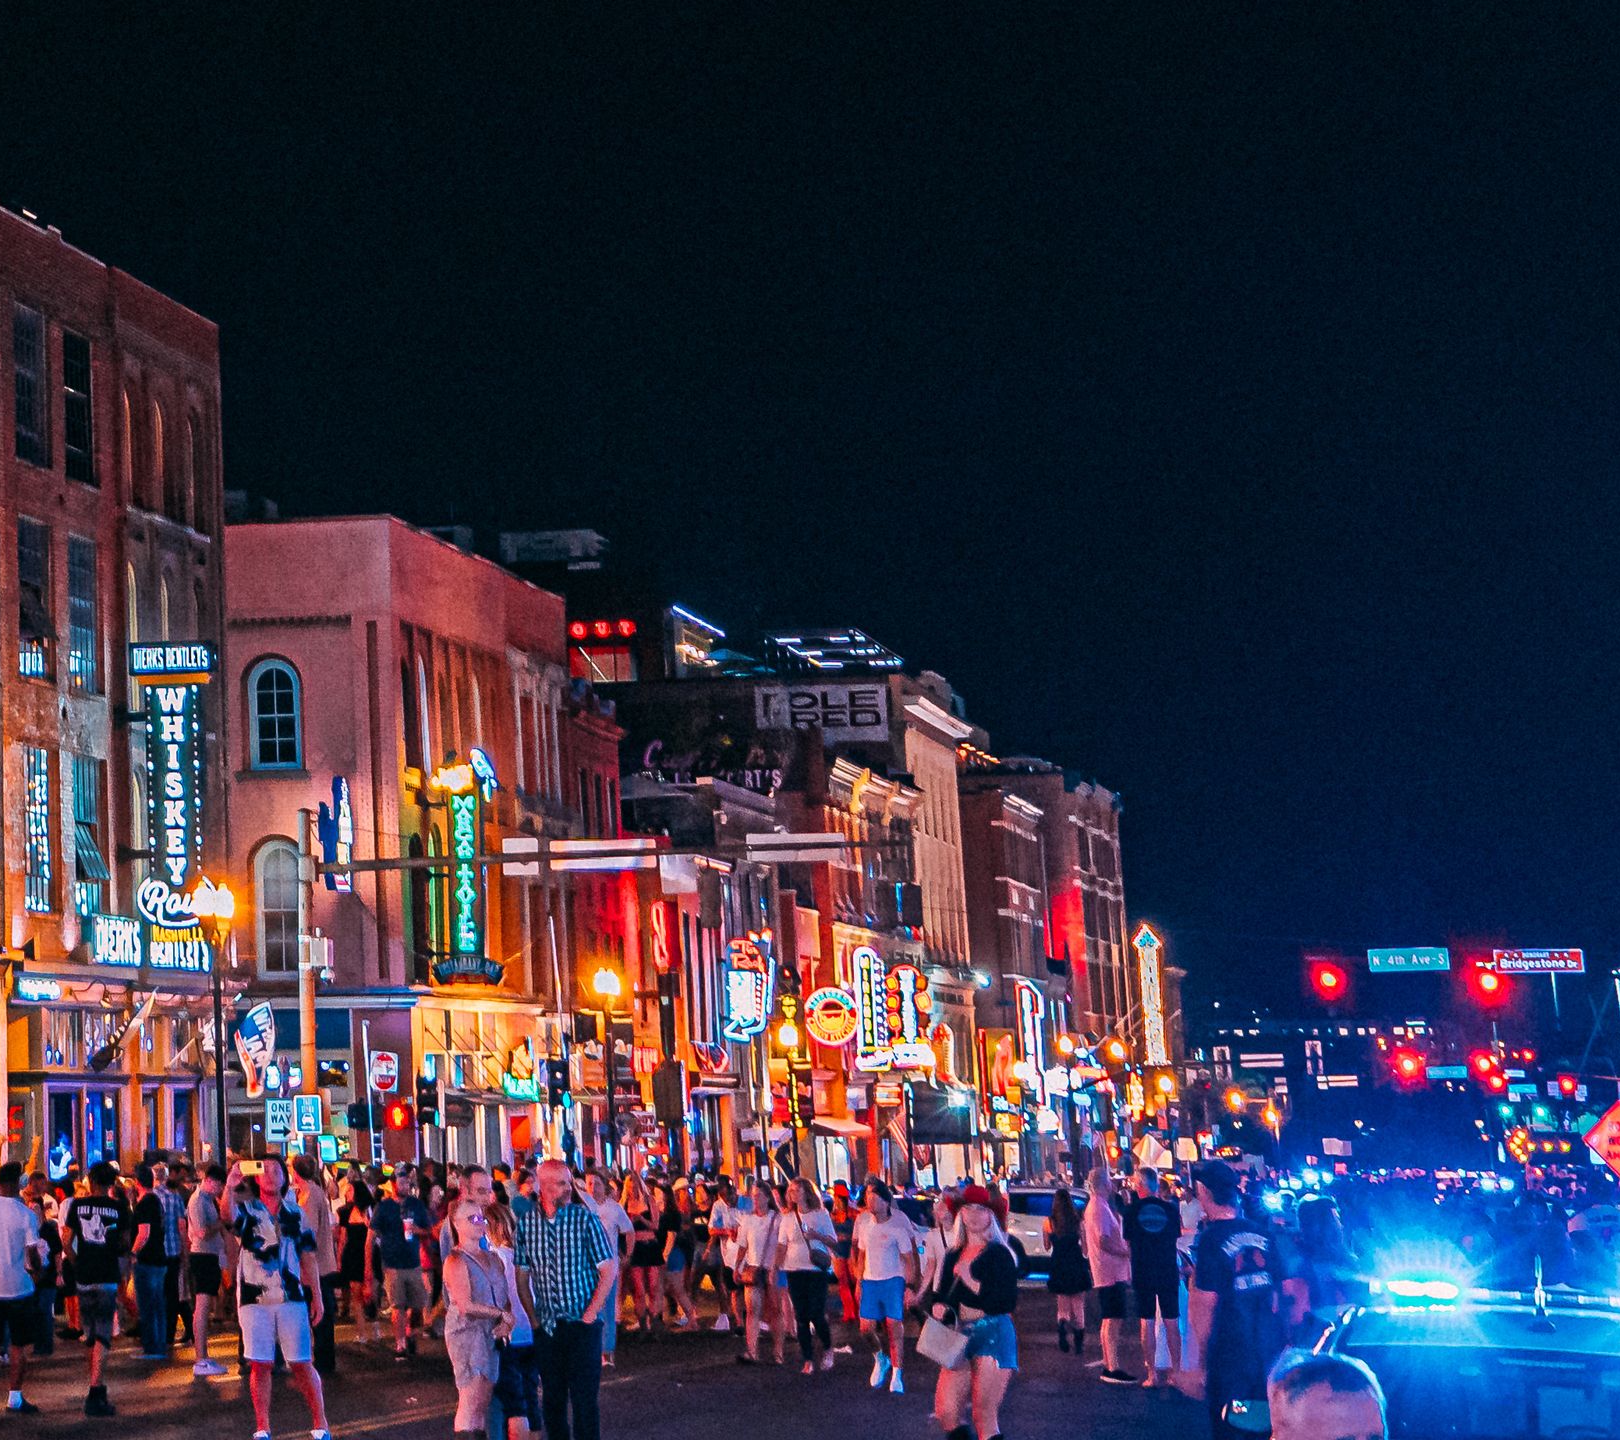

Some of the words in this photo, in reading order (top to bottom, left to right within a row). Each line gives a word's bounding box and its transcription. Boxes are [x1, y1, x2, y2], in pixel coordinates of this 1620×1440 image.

[131, 646, 164, 671] DIERKS
[155, 686, 188, 888] WHISKEY
[1372, 957, 1380, 966] N
[1387, 955, 1406, 966] 4th
[1411, 955, 1430, 965] Ave
[1437, 954, 1445, 965] S
[1500, 958, 1565, 970] Bridgestone
[271, 1103, 291, 1113] ONE
[270, 1113, 292, 1124] WAY
